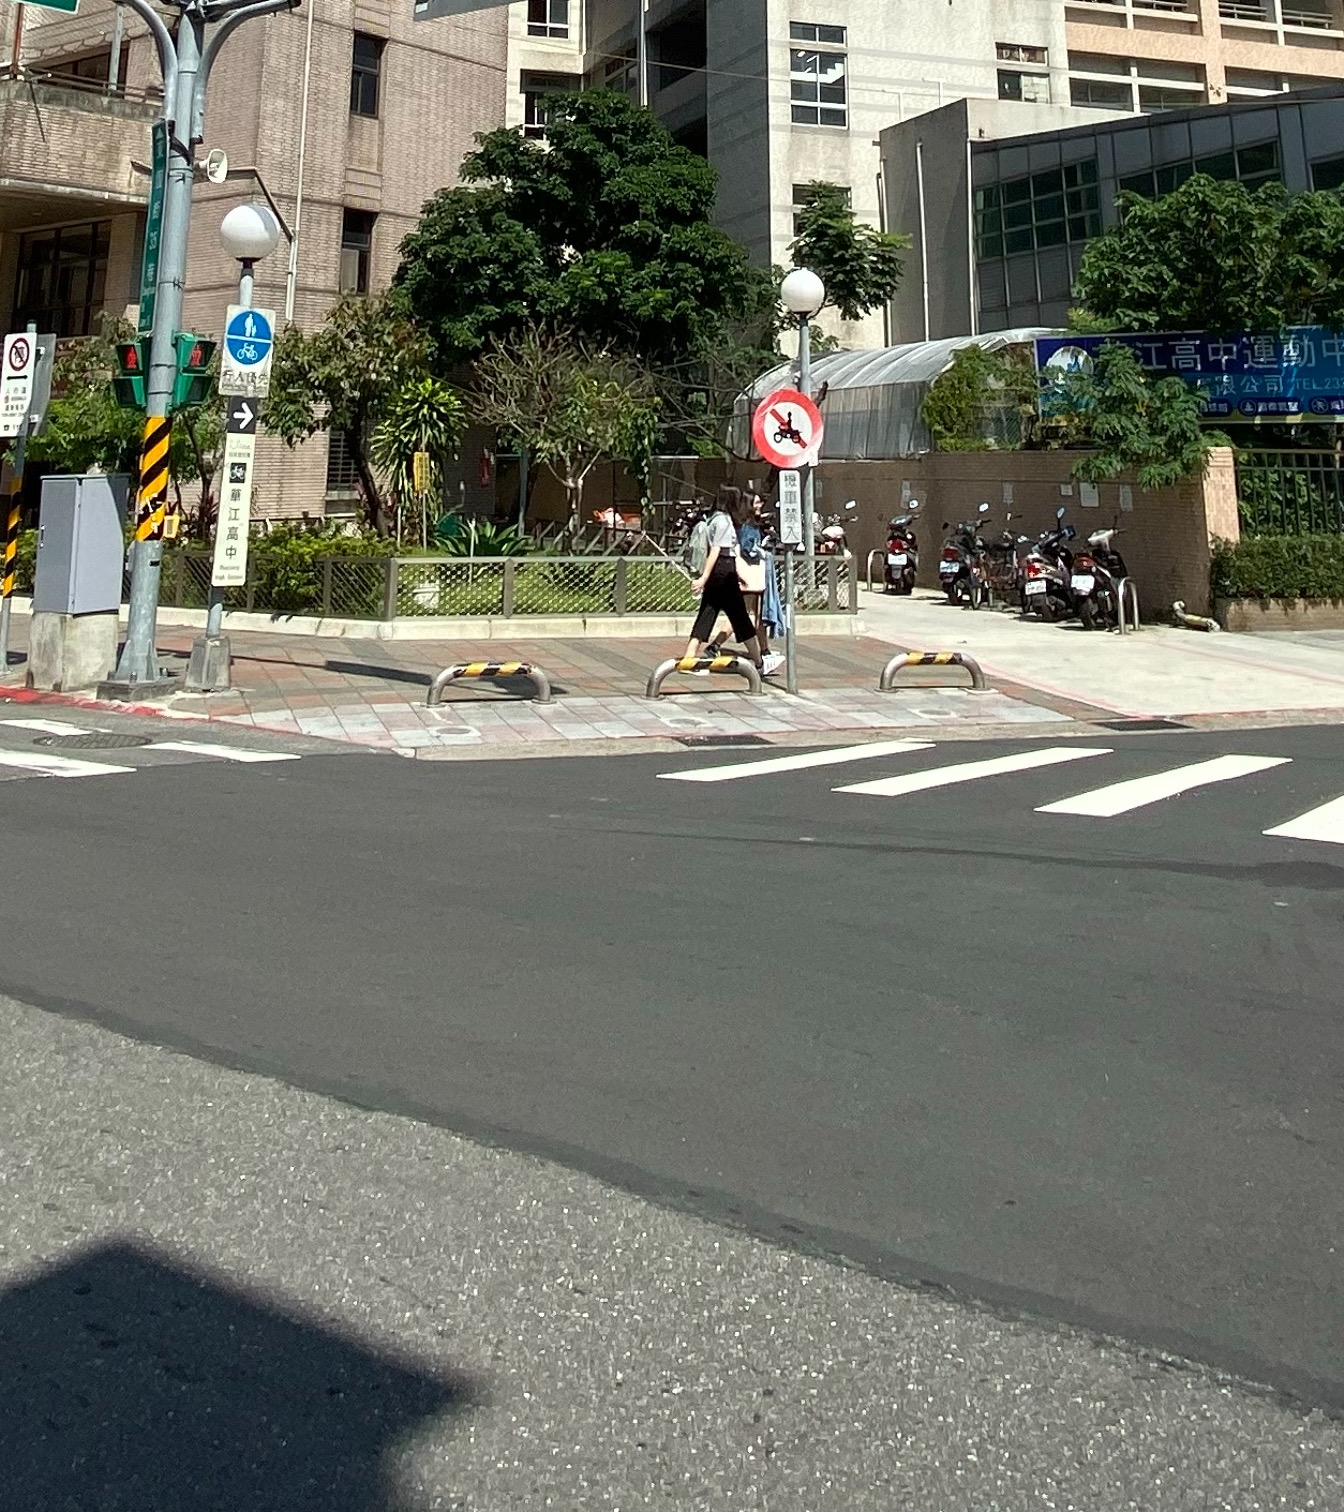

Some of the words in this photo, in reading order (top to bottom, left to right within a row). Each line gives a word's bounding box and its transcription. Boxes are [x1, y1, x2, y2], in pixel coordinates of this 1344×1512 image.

[225, 488, 242, 560] 華江高中
[784, 473, 799, 541] 機車禁入
